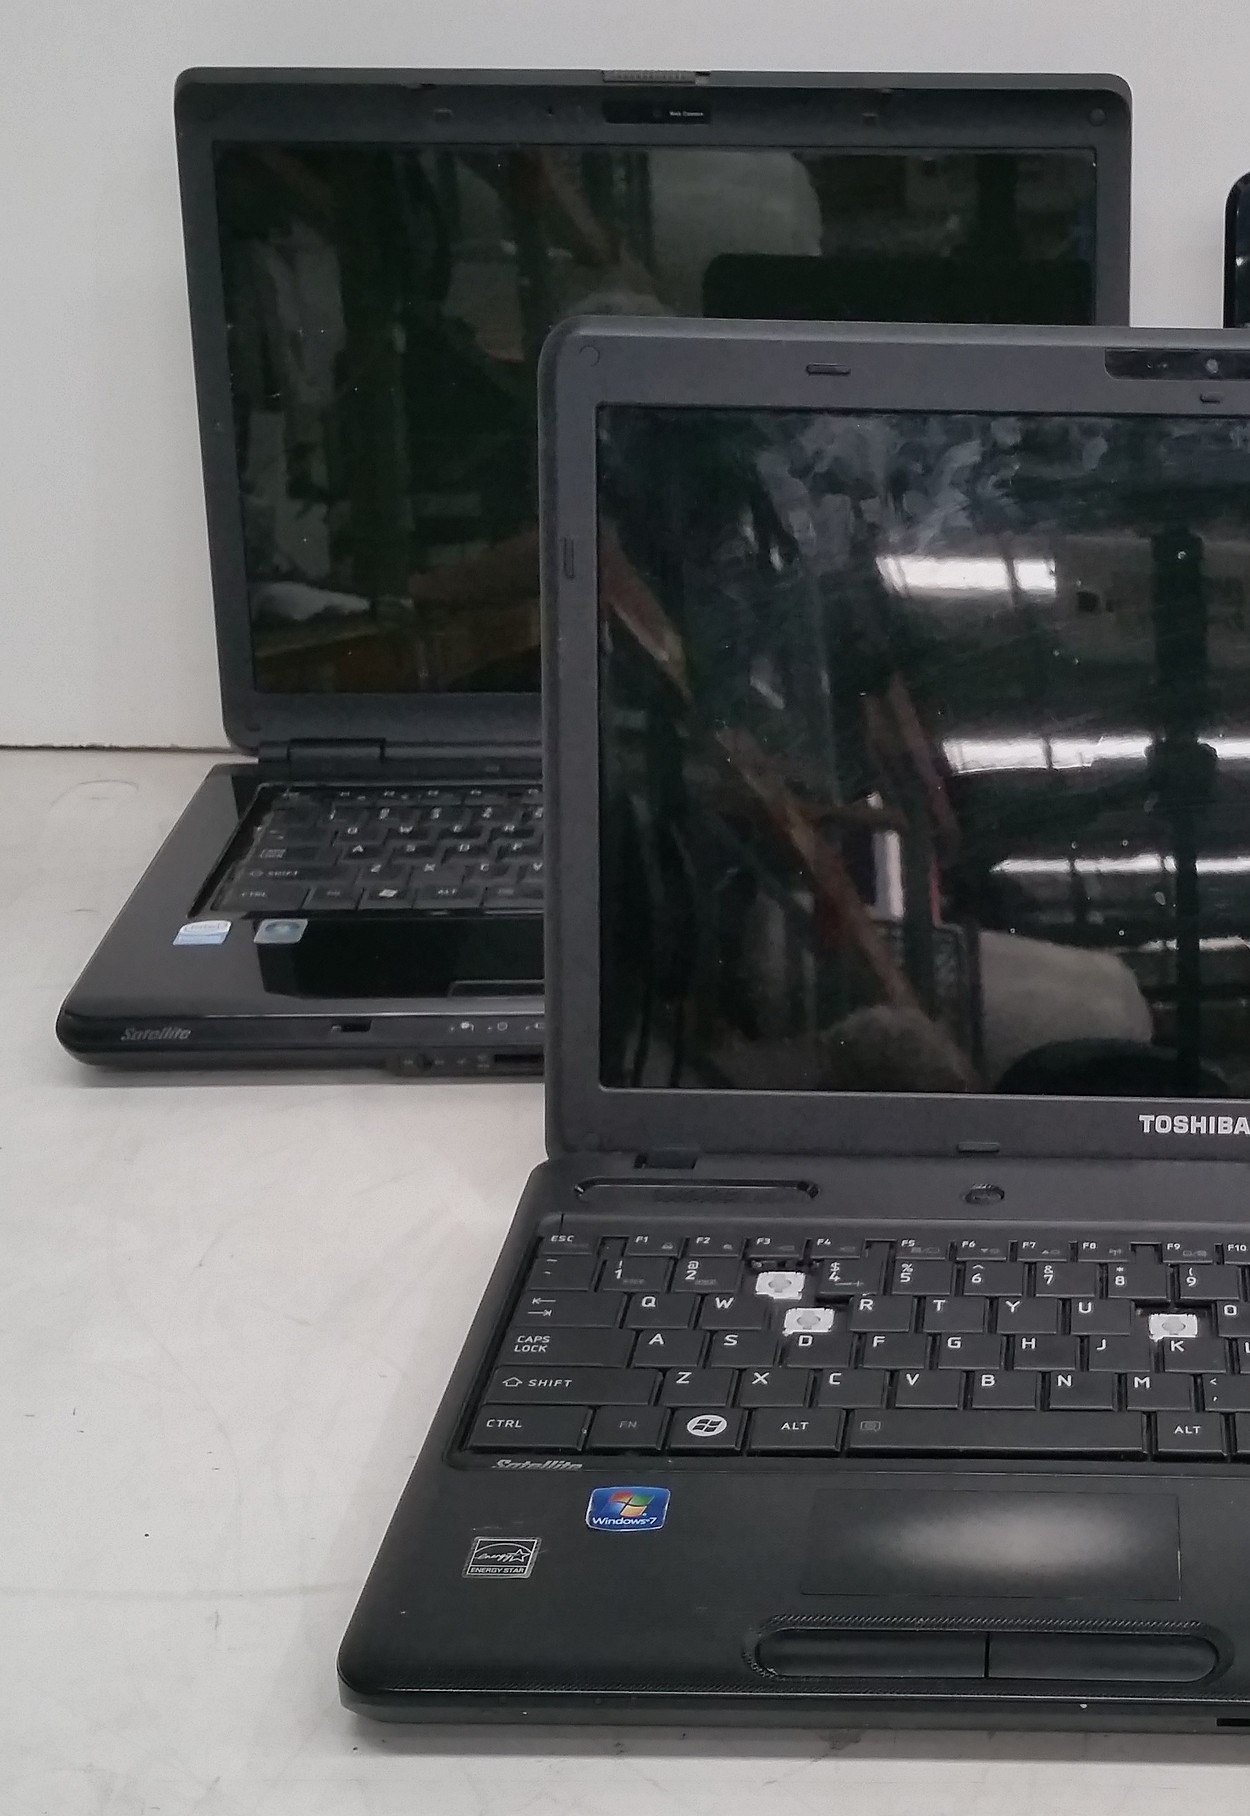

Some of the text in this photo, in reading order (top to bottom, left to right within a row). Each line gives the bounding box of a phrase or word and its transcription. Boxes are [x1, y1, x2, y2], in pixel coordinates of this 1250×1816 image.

[121, 1027, 191, 1040] Satellite
[1139, 1115, 1250, 1134] TOSHIBA
[615, 1269, 622, 1279] 1
[685, 1270, 697, 1280] 2
[829, 1272, 840, 1281] 4
[901, 1273, 911, 1282] 5
[972, 1273, 981, 1283] 6
[1044, 1274, 1053, 1284] 7
[1115, 1276, 1125, 1285] 8
[1187, 1277, 1196, 1286] 9
[642, 1297, 655, 1307] Q
[716, 1297, 734, 1308] W
[859, 1299, 873, 1310] R
[933, 1300, 945, 1311] T
[1006, 1301, 1020, 1312] Y
[1079, 1302, 1091, 1313] U
[649, 1334, 664, 1344] A
[724, 1335, 738, 1345] S
[799, 1335, 812, 1346] D
[873, 1336, 885, 1347] F
[948, 1337, 961, 1348] G
[1022, 1338, 1035, 1349] H
[1097, 1339, 1106, 1350] J
[1171, 1341, 1184, 1351] K
[528, 1379, 572, 1387] SHIFT
[676, 1372, 692, 1383] Z
[752, 1373, 769, 1384] X
[829, 1373, 841, 1385] C
[906, 1374, 919, 1385] V
[982, 1375, 995, 1386] B
[1058, 1375, 1071, 1386] N
[1135, 1377, 1150, 1388] M
[487, 1419, 521, 1427] CTRL
[781, 1422, 808, 1430] ALT
[1175, 1426, 1200, 1434] ALT
[492, 1459, 582, 1469] Satellite
[649, 1517, 657, 1525] 7
